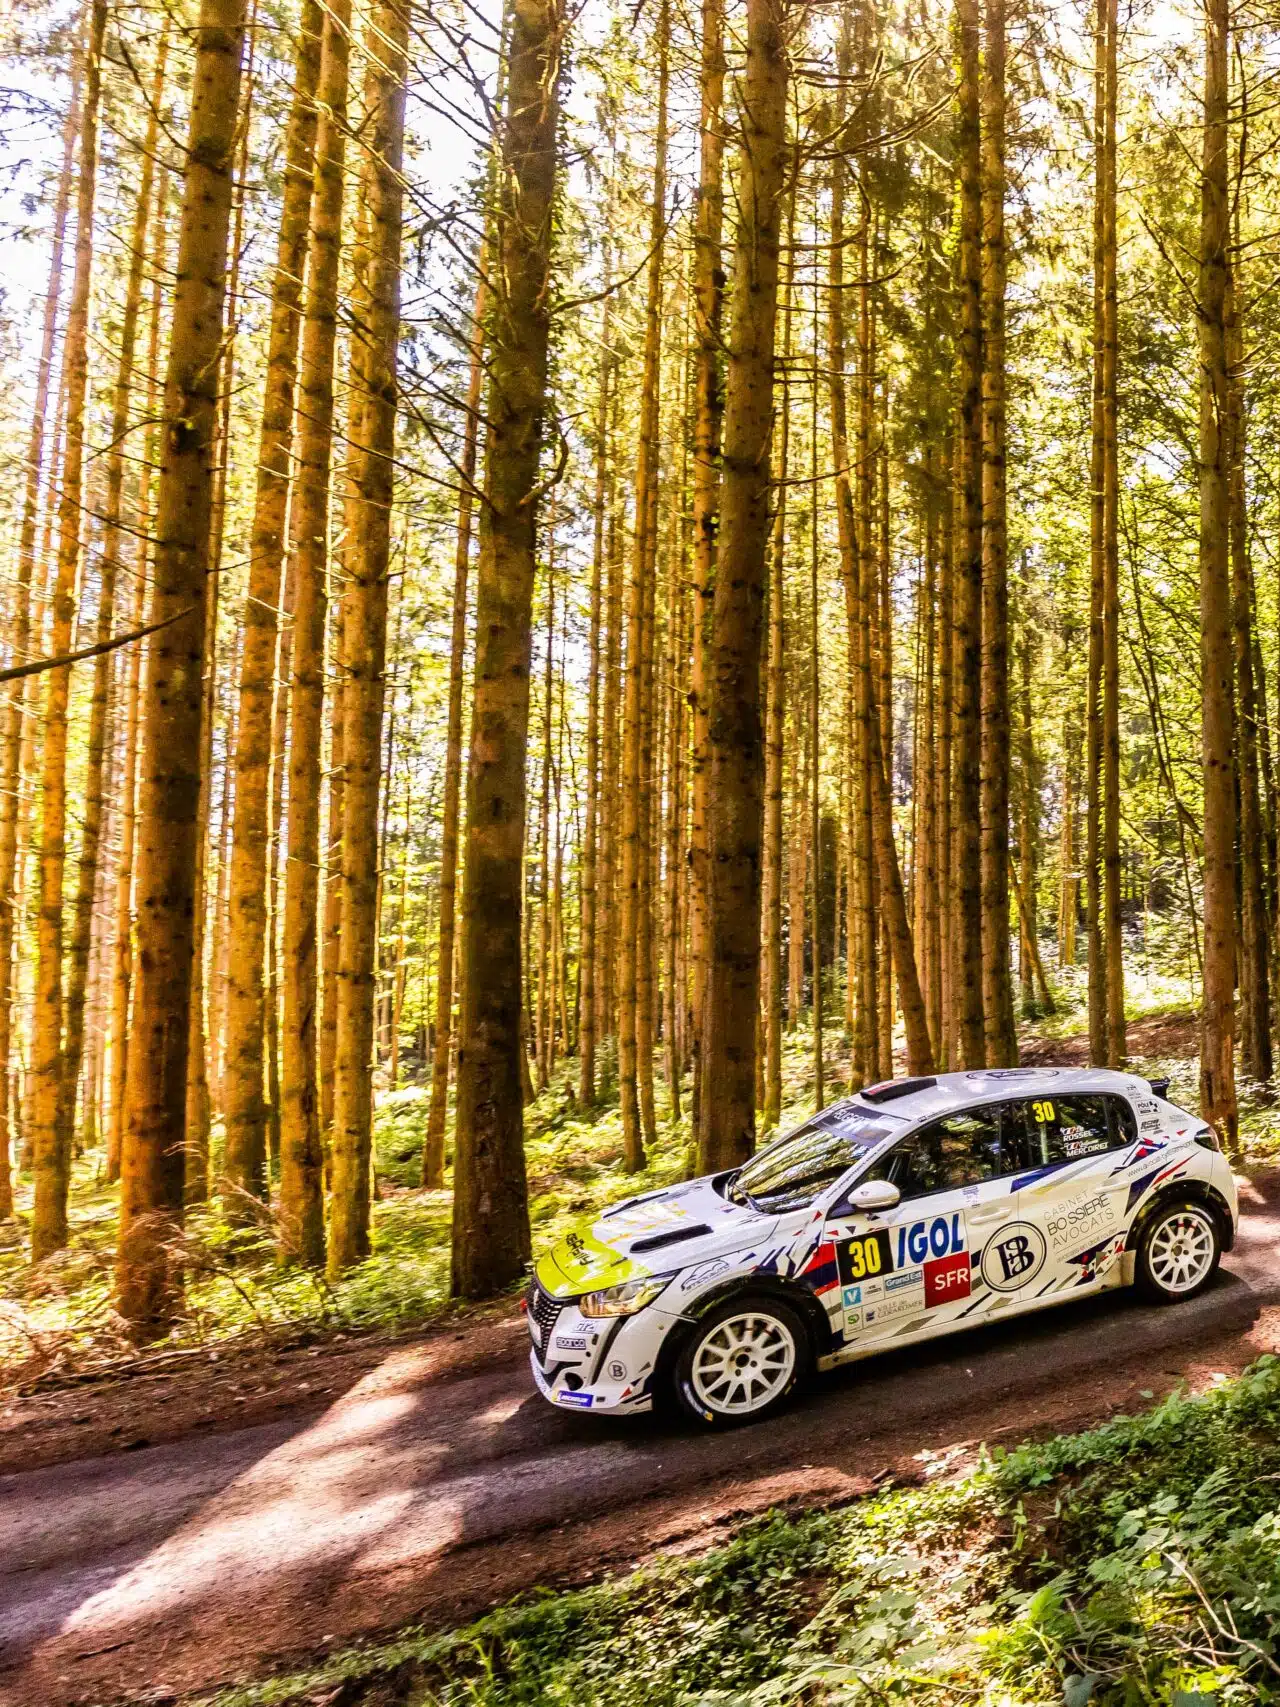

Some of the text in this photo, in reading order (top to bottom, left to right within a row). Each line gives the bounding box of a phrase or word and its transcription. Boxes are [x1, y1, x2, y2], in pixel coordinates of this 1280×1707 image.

[1032, 1101, 1055, 1123] 30
[1063, 1130, 1094, 1142] ROSSEL
[1066, 1141, 1109, 1158] MERCOIRET
[1044, 1190, 1088, 1221] CABINET
[1053, 1208, 1114, 1248] AVOCATS
[897, 1213, 964, 1268] IGOL
[848, 1237, 881, 1278] 30
[886, 1274, 909, 1287] Grand
[934, 1267, 969, 1290] SFR
[612, 1364, 623, 1377] B
